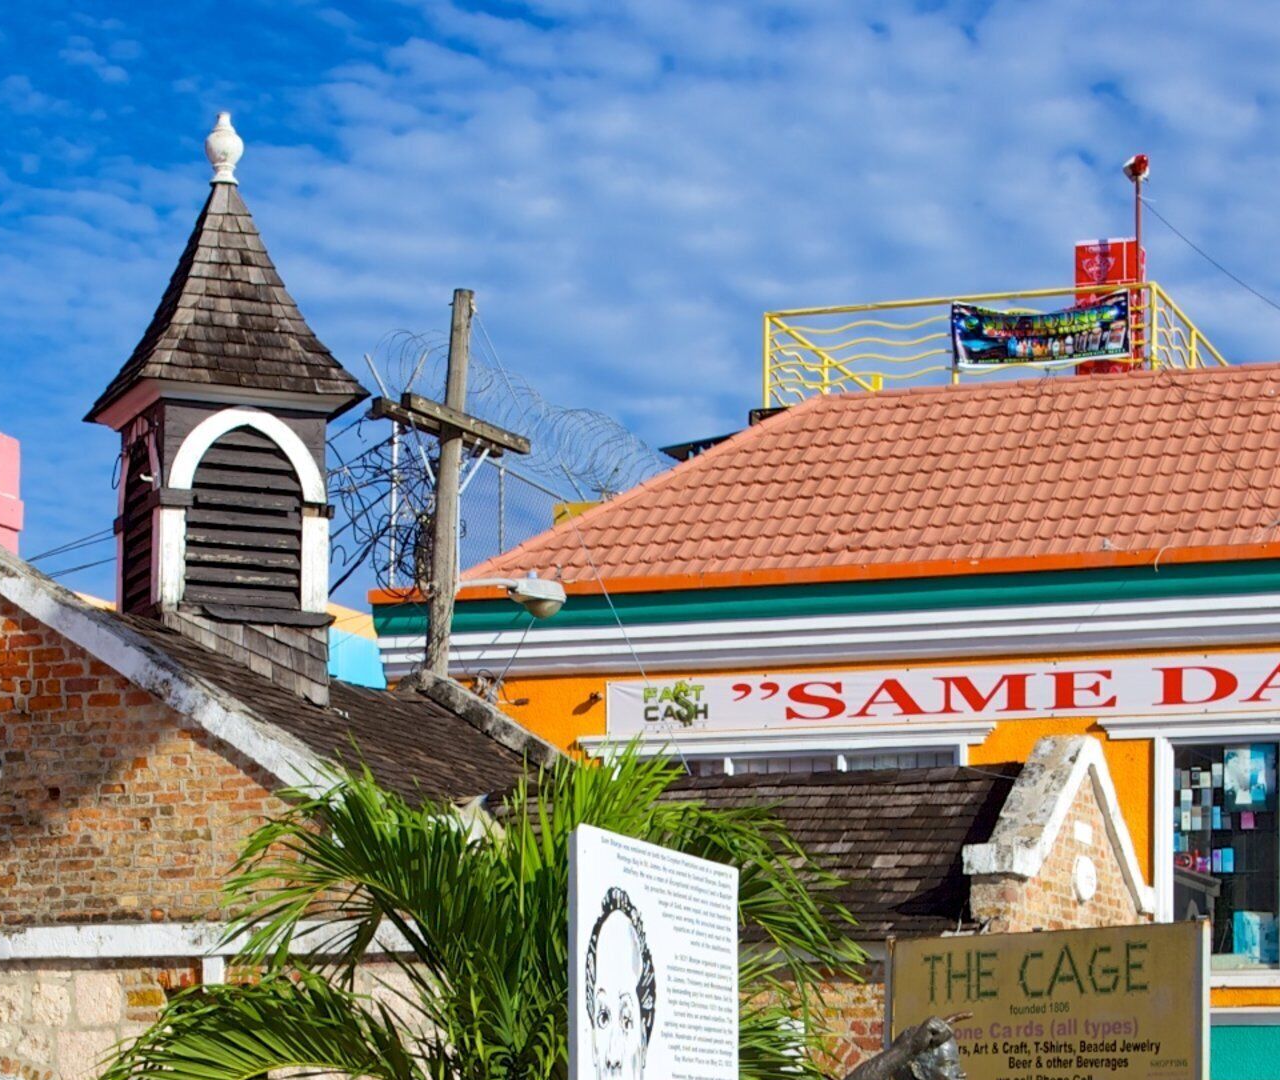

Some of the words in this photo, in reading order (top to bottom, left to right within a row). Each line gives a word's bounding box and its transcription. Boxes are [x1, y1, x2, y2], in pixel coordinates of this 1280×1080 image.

[923, 951, 999, 1004] THE
[1019, 941, 1150, 998] CAGE
[1009, 1003, 1047, 1015] founded
[1049, 1002, 1070, 1014] 1806
[989, 1021, 1045, 1039] Cards
[1050, 1018, 1078, 1041] (all
[1085, 1016, 1139, 1040] types)
[973, 1043, 989, 1054] Art
[991, 1043, 999, 1054] &
[1002, 1041, 1032, 1057] Craft,
[1034, 1040, 1075, 1056] T-Shirts,
[1079, 1039, 1117, 1053] Beaded
[1119, 1038, 1161, 1056] Jewelry
[1008, 1057, 1033, 1069] Beer
[1035, 1057, 1043, 1069] &
[1046, 1056, 1073, 1069] other
[1076, 1055, 1129, 1070] Beverages
